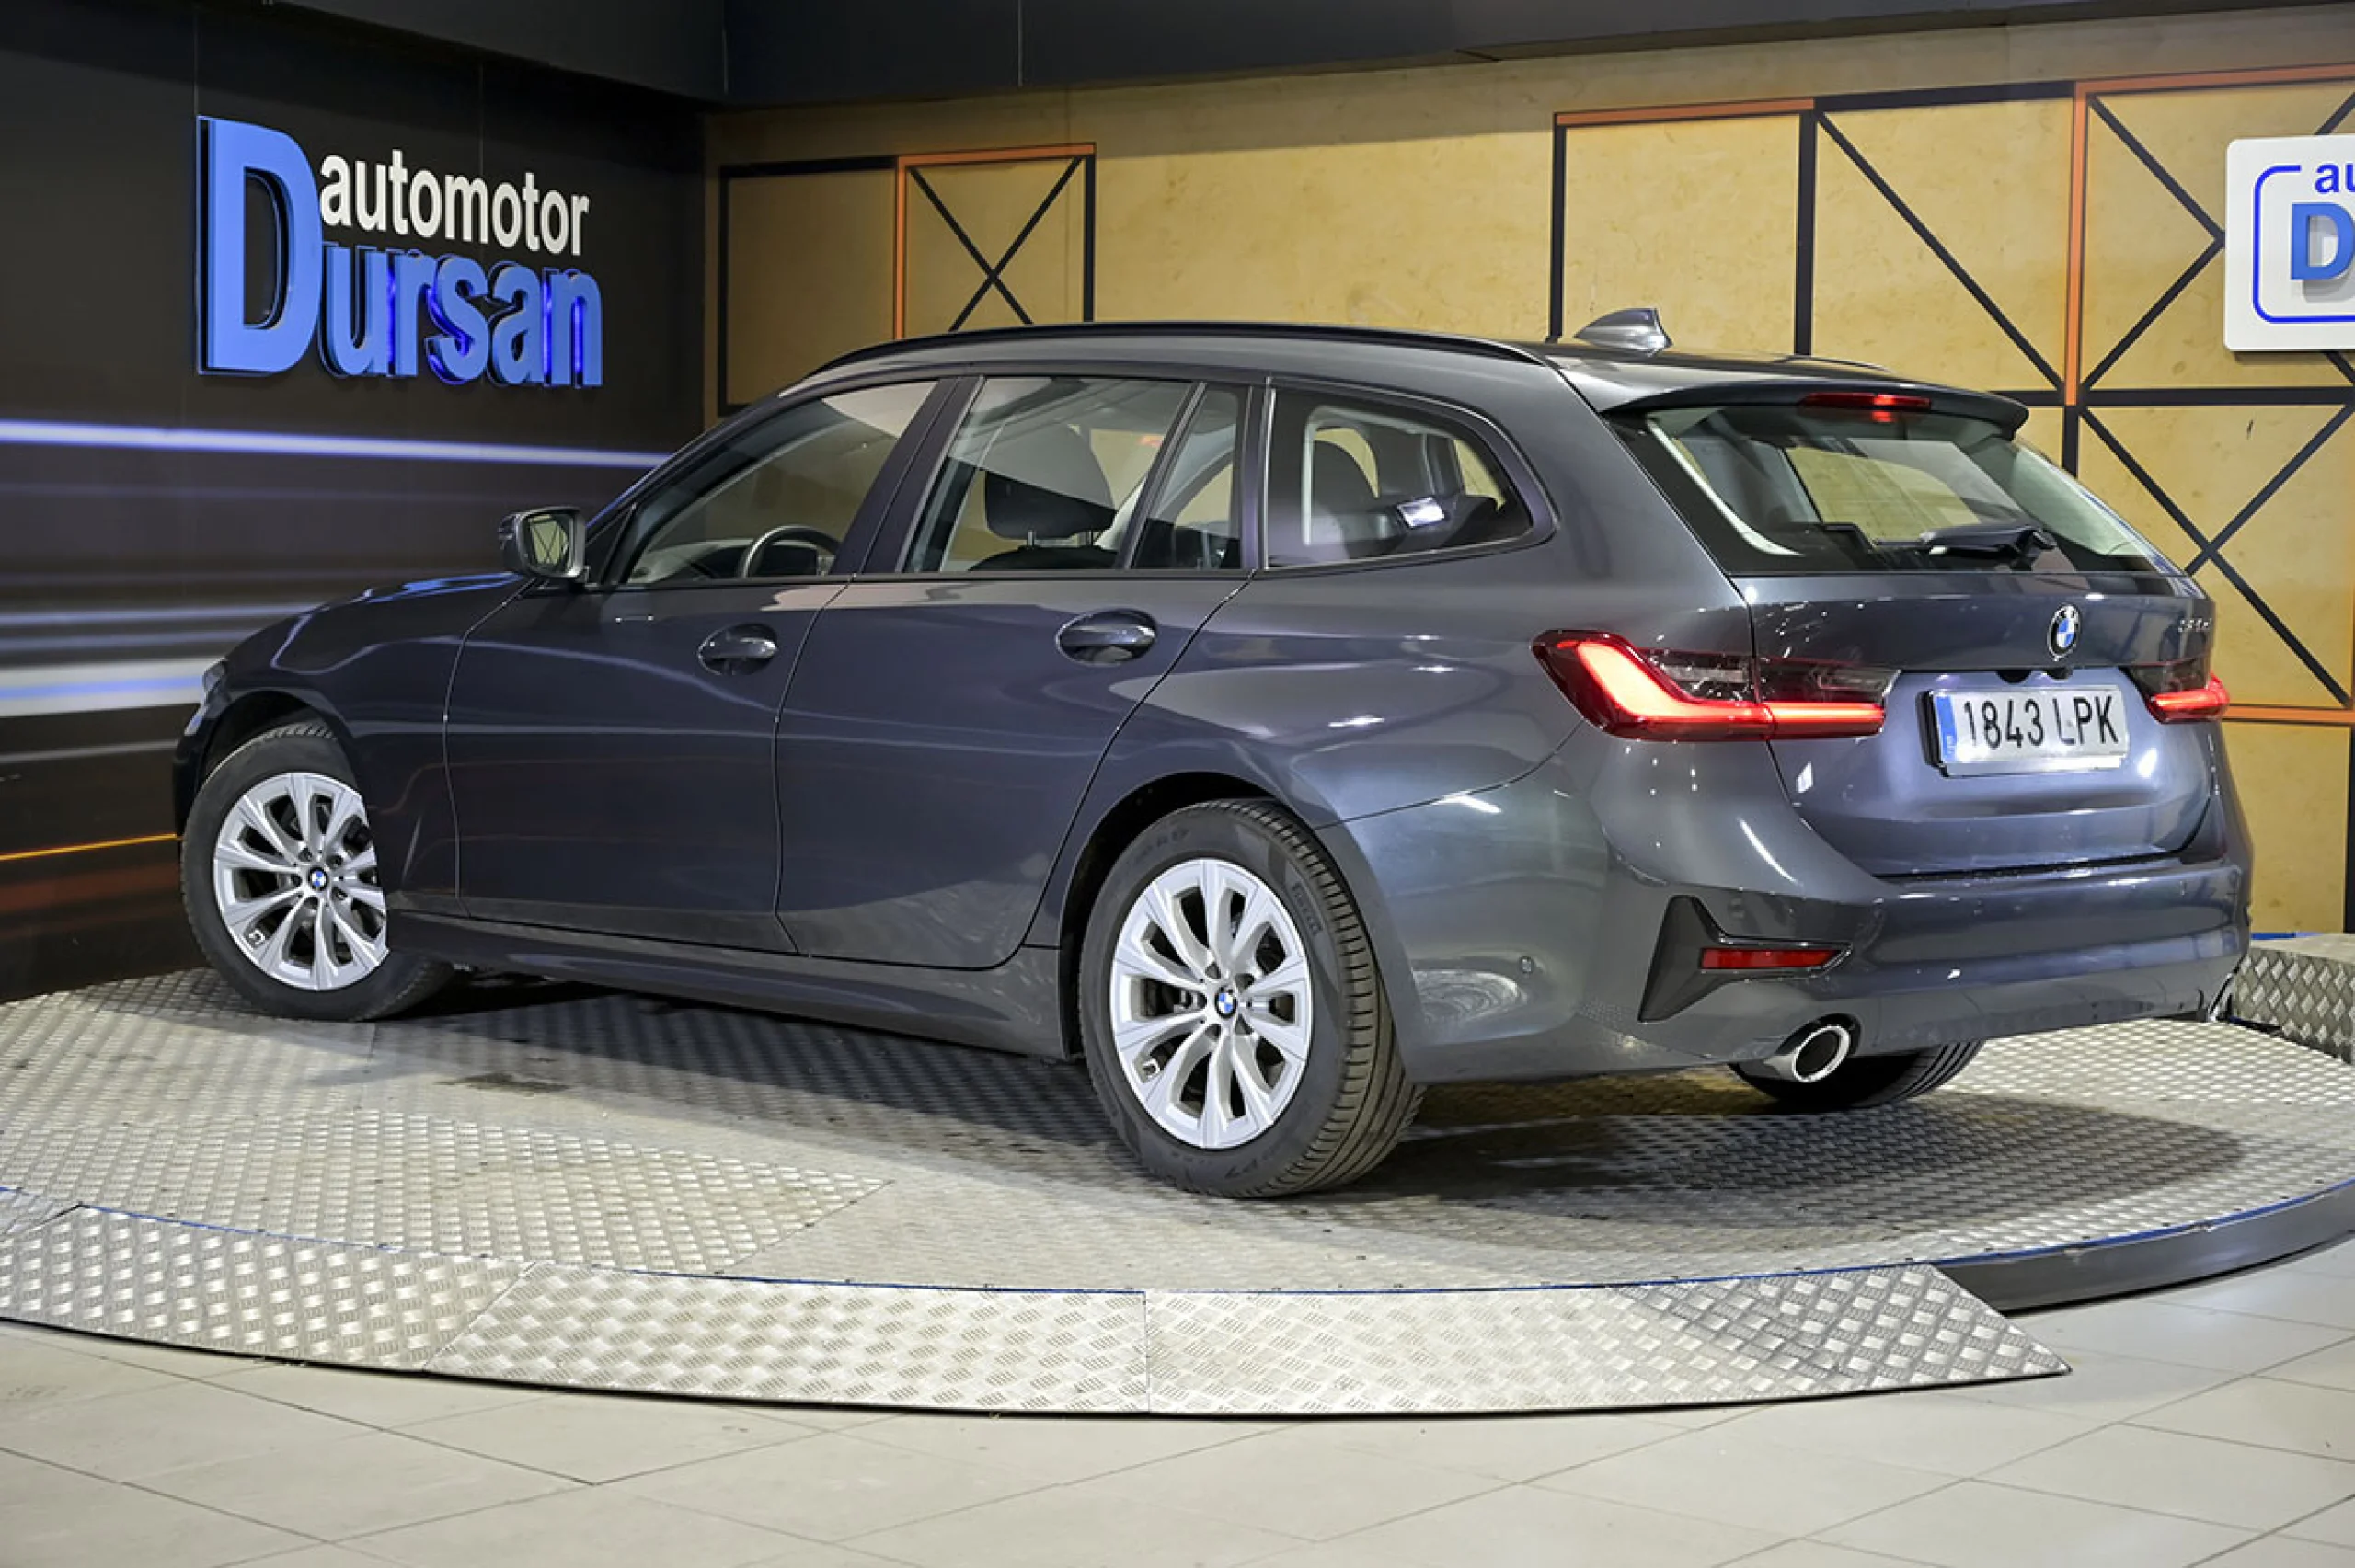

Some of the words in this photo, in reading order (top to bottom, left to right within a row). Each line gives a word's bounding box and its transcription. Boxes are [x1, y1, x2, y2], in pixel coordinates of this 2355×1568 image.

[196, 115, 603, 388] Dursan
[320, 149, 590, 256] automotor
[1964, 698, 2044, 750] 1843
[2052, 694, 2119, 746] LPK
